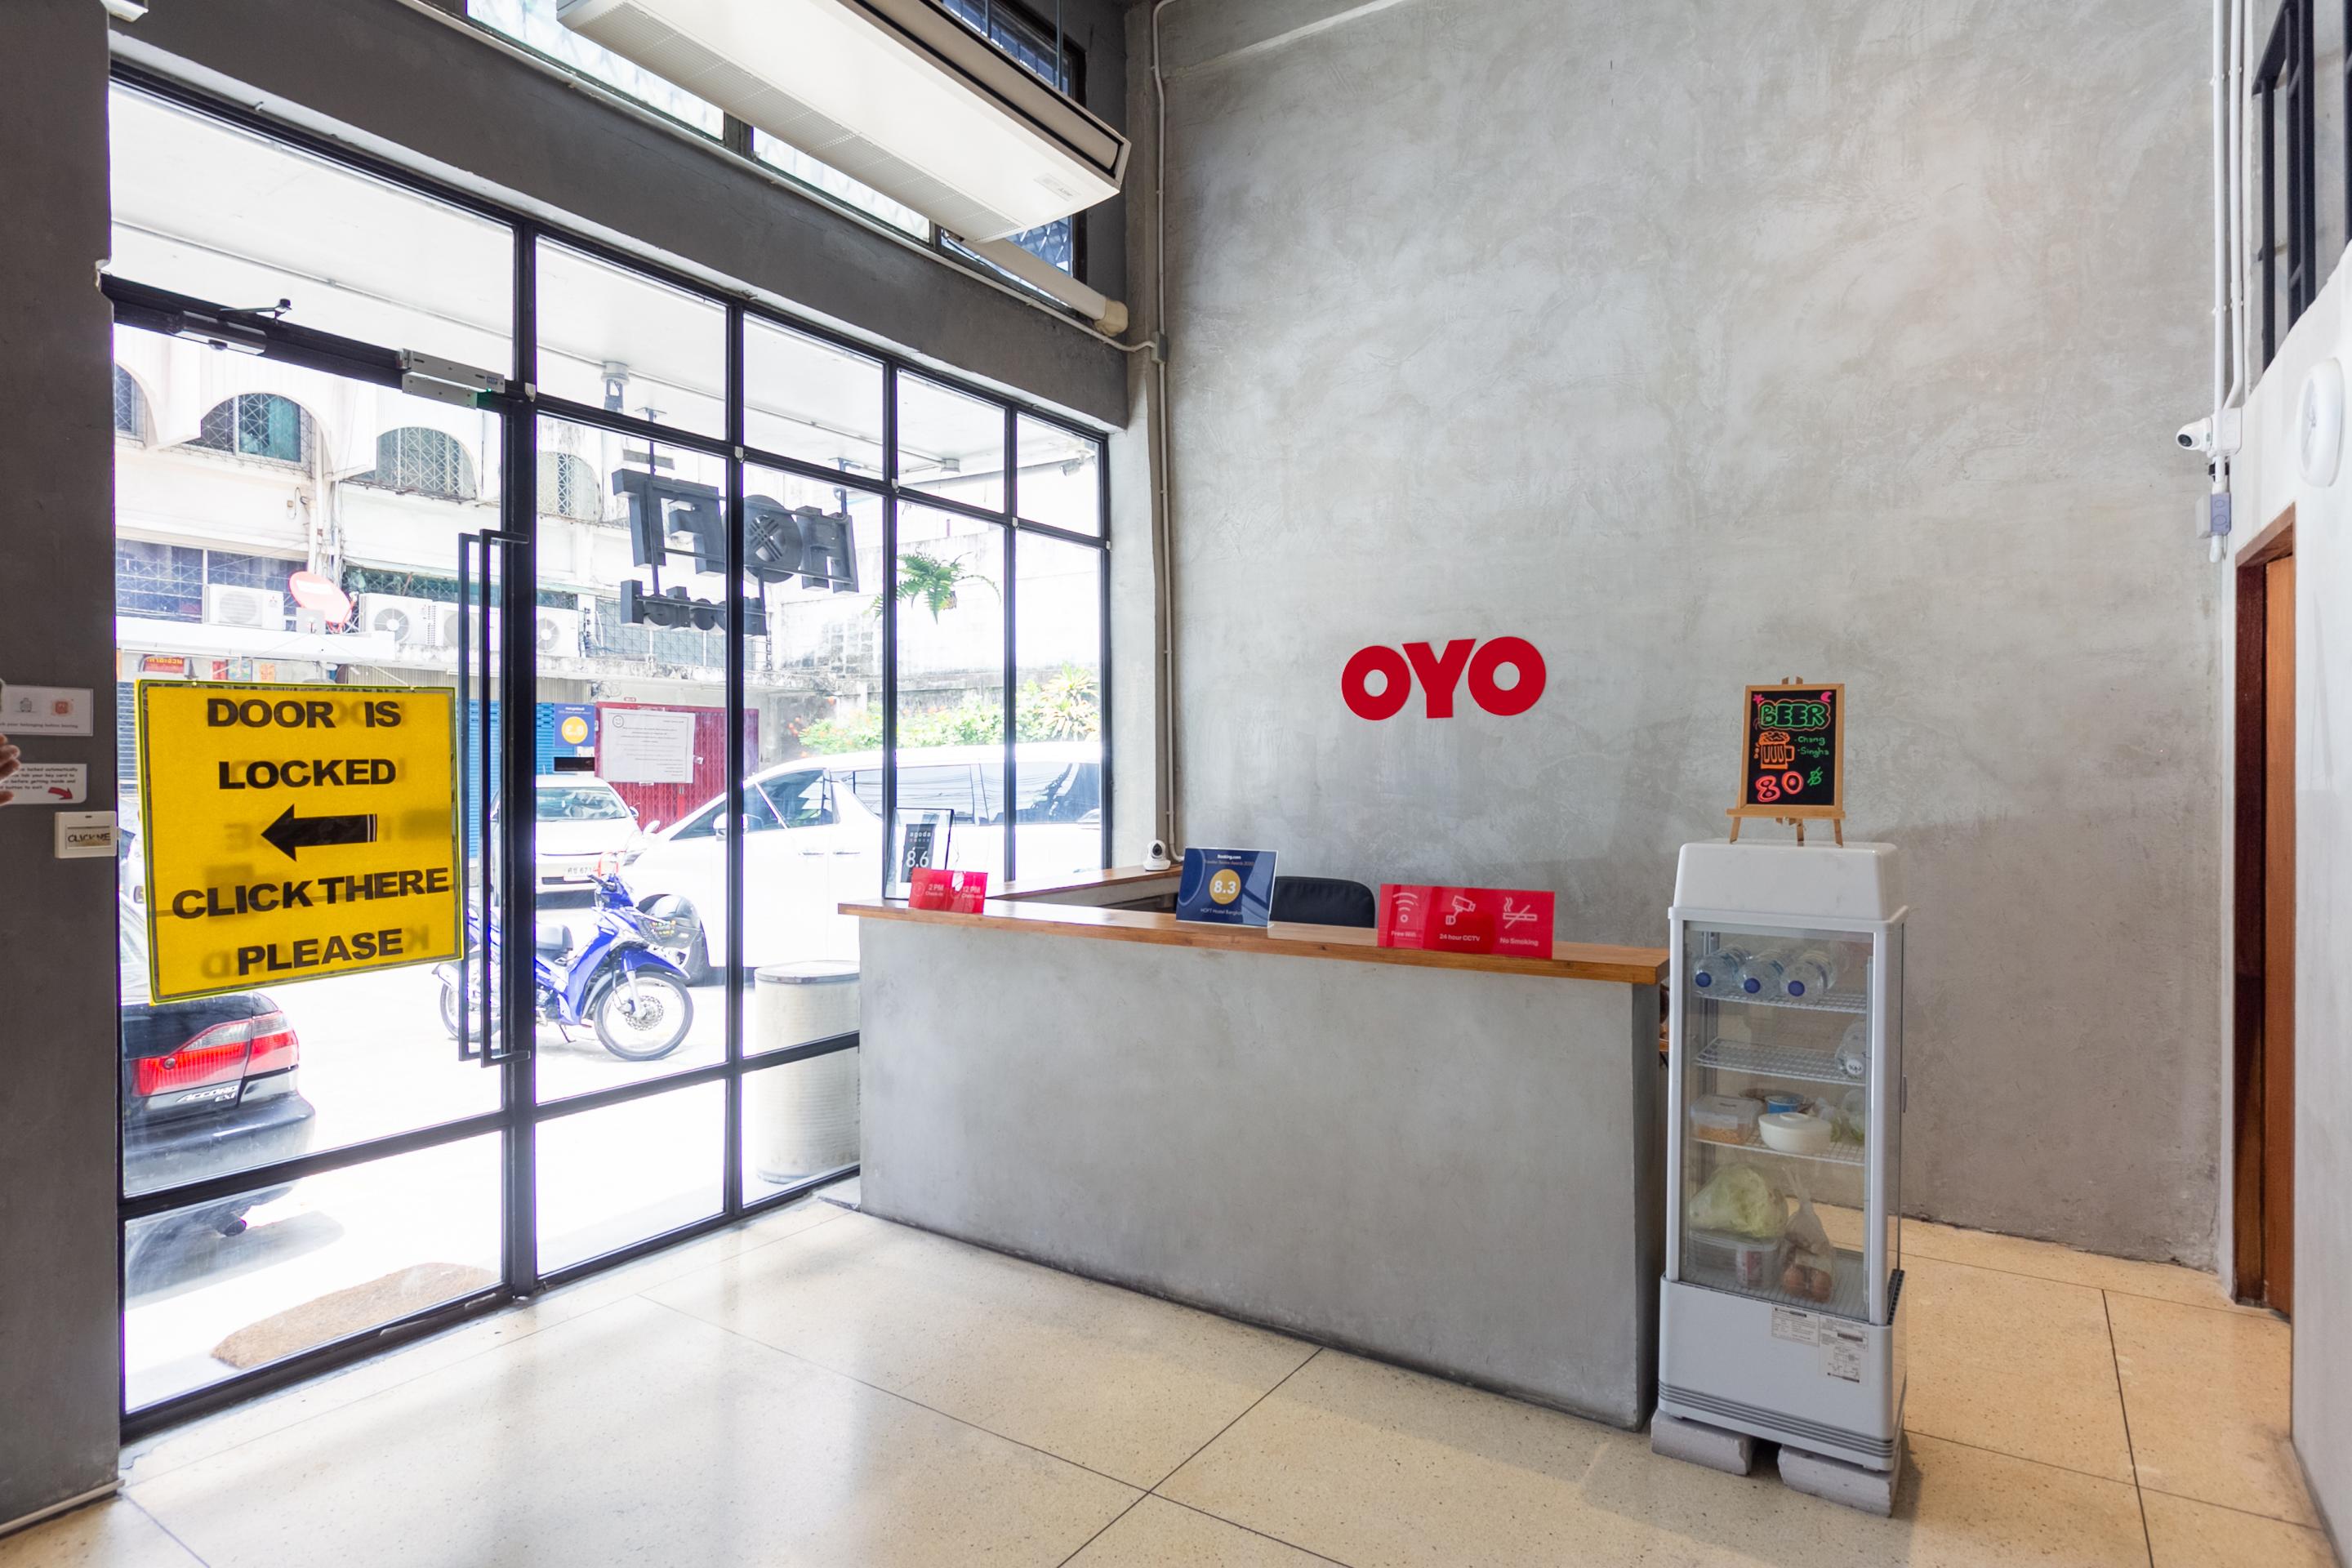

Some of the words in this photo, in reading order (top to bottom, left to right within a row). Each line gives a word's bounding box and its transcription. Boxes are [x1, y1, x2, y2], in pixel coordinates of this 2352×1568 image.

[1341, 636, 1547, 721] OYO
[207, 698, 336, 728] DOOR
[364, 700, 402, 728] IS
[1762, 704, 1825, 727] BEER
[218, 759, 396, 790] LOCKED
[906, 850, 929, 867] 8.6
[172, 880, 314, 920] CLICK
[317, 867, 449, 905] THERE
[1214, 880, 1236, 894] 8.3
[238, 928, 403, 976] PLEASE
[1510, 938, 1539, 947] Smoking
